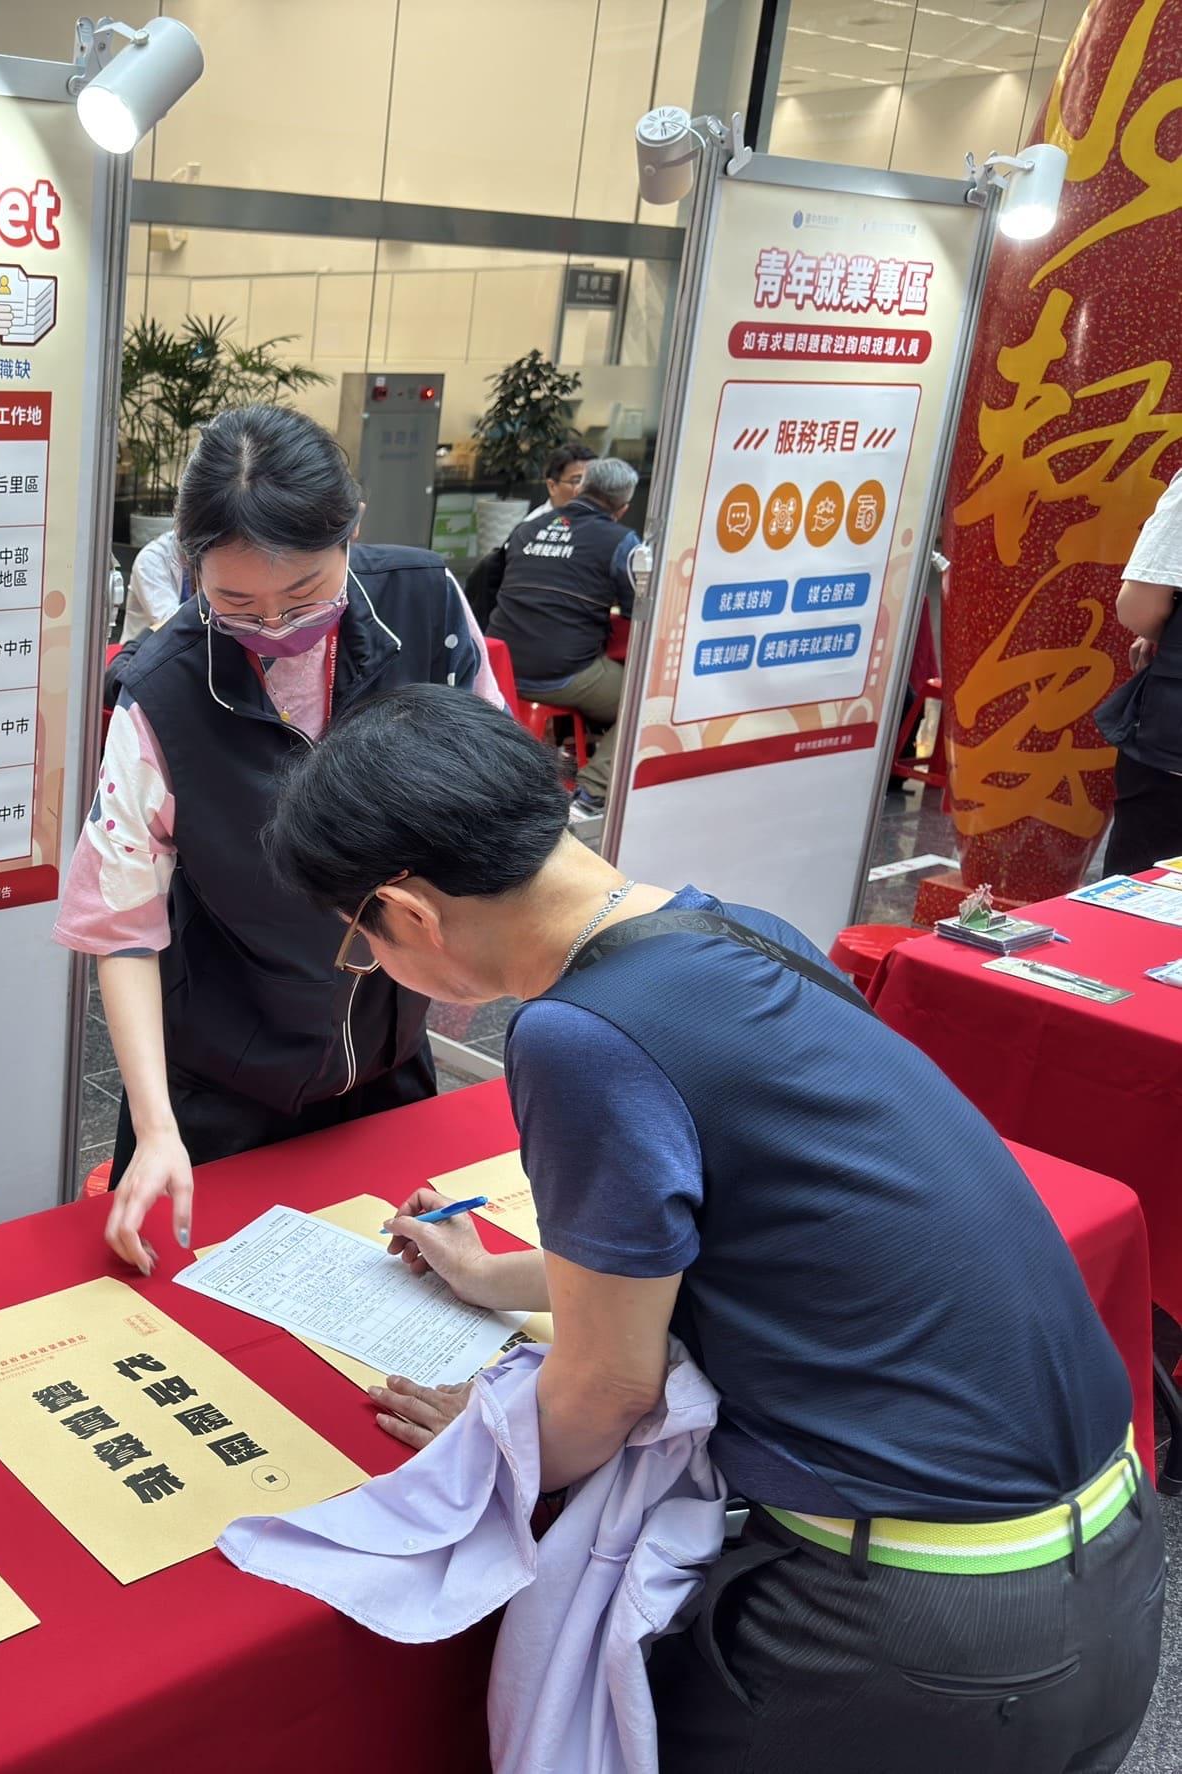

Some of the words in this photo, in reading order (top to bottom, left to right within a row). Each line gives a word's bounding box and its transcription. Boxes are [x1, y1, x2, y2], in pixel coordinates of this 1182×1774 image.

[754, 247, 934, 316] 青年就業專區
[742, 331, 921, 357] 如有求職問題歡迎詢問現場人員
[774, 419, 860, 455] 服務項目
[0, 547, 30, 566] 中部
[719, 588, 773, 613] 就業諮詢
[807, 582, 856, 606] 媒合服務
[699, 644, 750, 668] 職業訓練
[112, 1352, 269, 1467] 代收履歷
[31, 1380, 187, 1505] 饗賓餐旅
